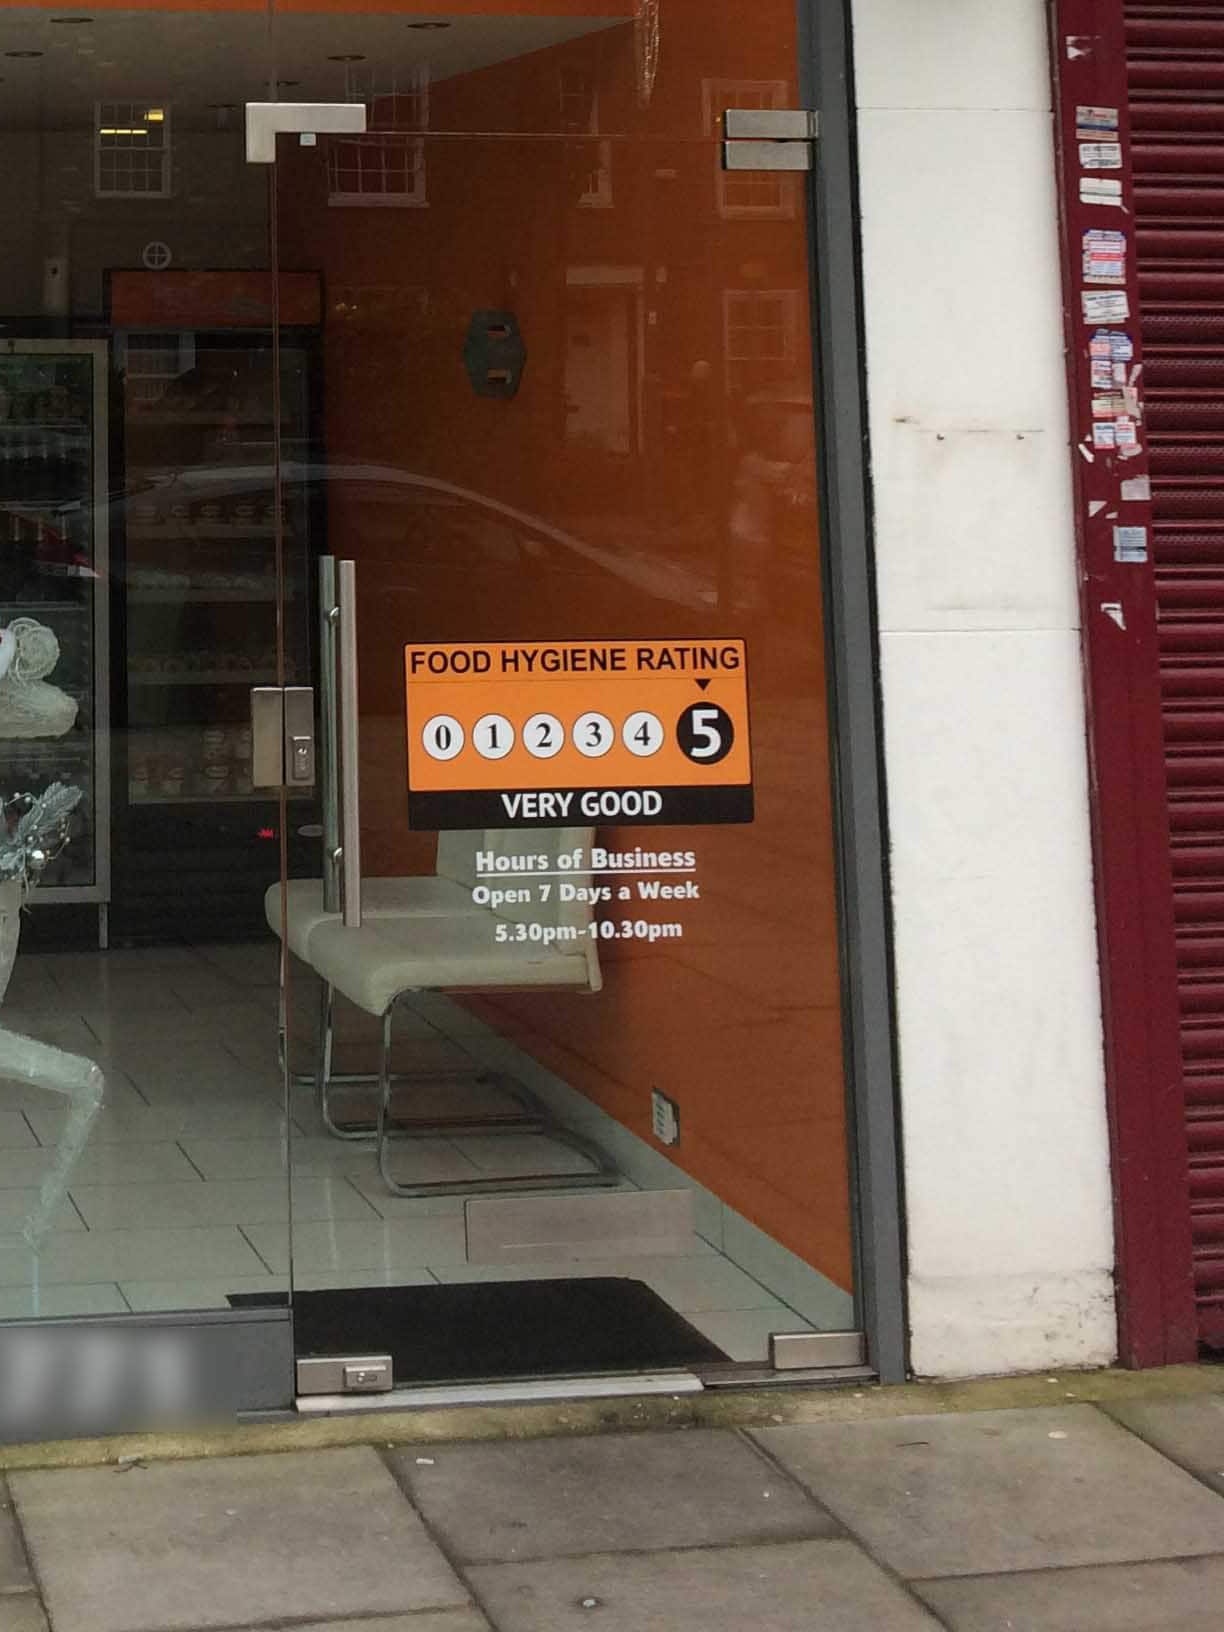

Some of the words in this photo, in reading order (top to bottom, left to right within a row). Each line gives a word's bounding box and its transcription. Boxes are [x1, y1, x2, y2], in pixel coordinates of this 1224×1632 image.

[411, 651, 491, 673] FOOD
[501, 648, 626, 672] HYGIENE
[637, 646, 740, 670] RATING
[434, 724, 452, 751] 0
[487, 723, 501, 749] 1
[535, 721, 553, 748] 2
[584, 721, 603, 748] 3
[633, 719, 651, 746] 4
[689, 708, 723, 758] 5
[501, 792, 574, 818] VERY
[580, 790, 663, 817] GOOD
[476, 851, 549, 871] Hours
[557, 848, 583, 869] of
[591, 848, 696, 869] Business
[472, 885, 531, 909] Open
[538, 884, 552, 902] 7
[559, 883, 612, 905] Days
[618, 886, 632, 900] a
[637, 881, 700, 900] Week
[495, 920, 684, 945] 5.30pm-10.30pm
